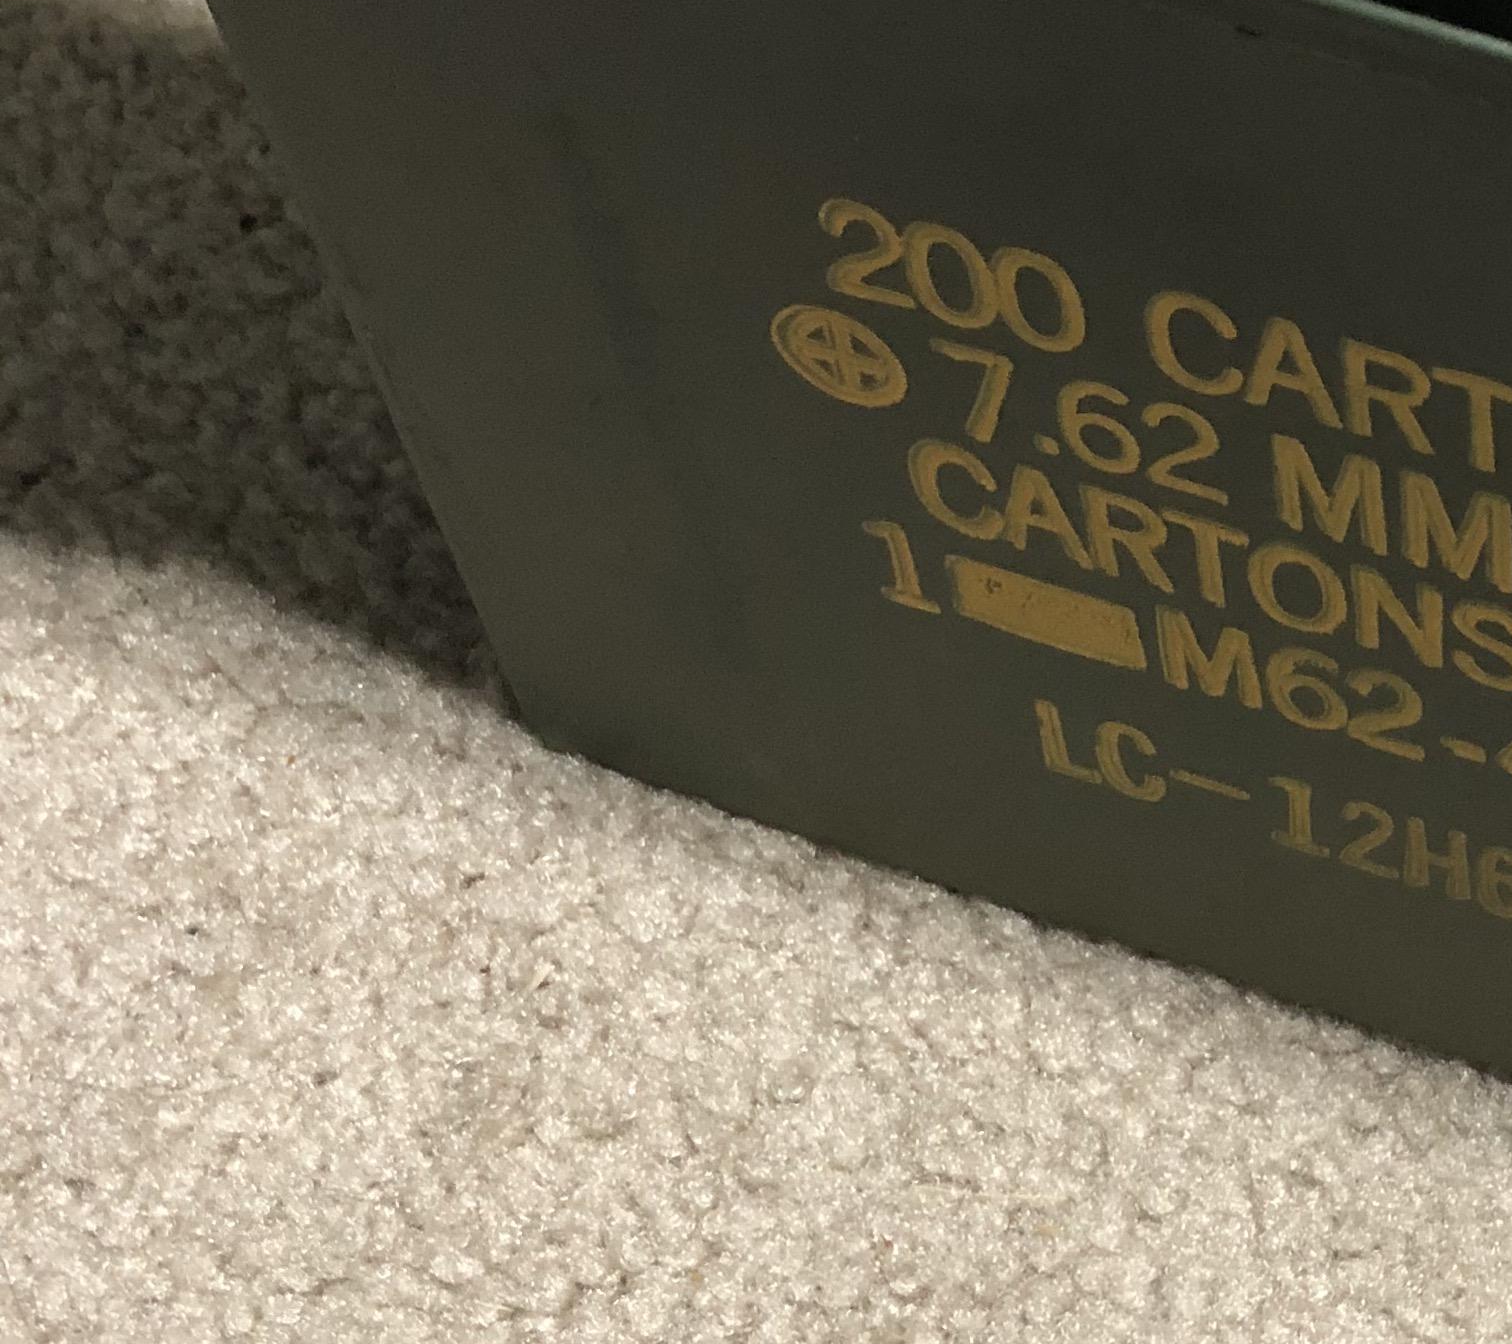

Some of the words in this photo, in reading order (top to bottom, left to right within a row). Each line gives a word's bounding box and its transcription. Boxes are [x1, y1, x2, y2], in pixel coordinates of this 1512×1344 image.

[819, 197, 1087, 354] 200
[930, 337, 1229, 506] 7.62
[862, 519, 942, 614] 1
